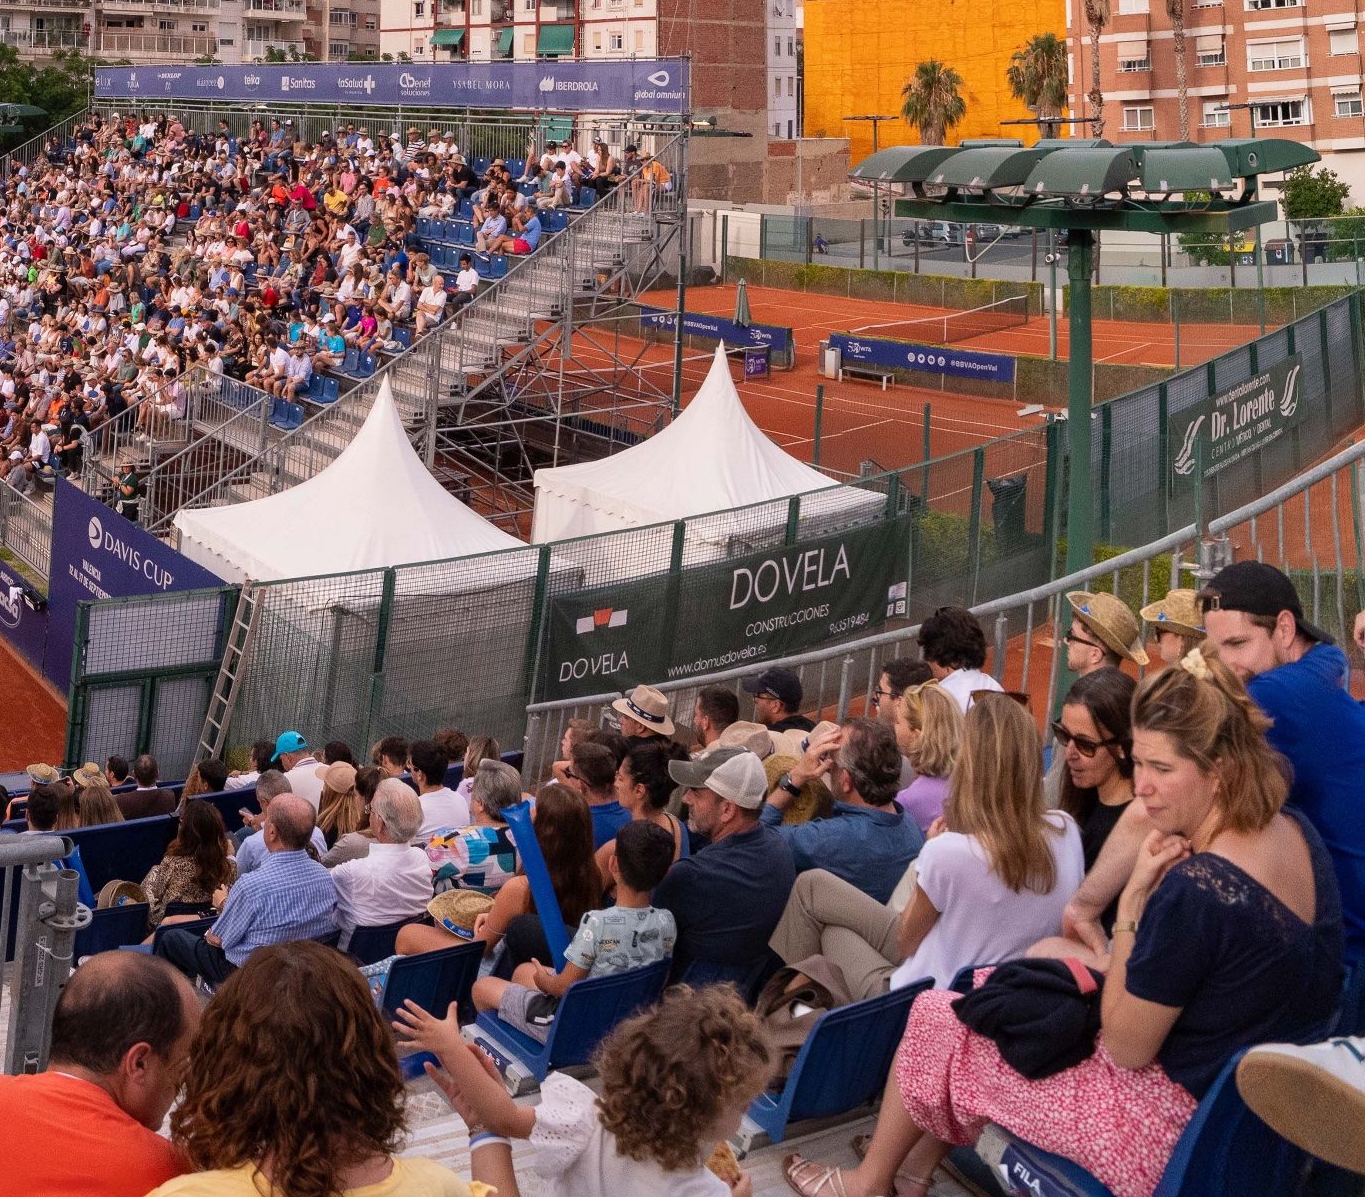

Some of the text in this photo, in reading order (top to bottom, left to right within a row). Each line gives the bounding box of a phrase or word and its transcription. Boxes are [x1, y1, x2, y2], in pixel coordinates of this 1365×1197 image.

[244, 74, 260, 85] teika
[290, 77, 315, 89] Sanitas
[453, 80, 510, 90] YSABEL MORA
[555, 81, 598, 92] IBERDROLA
[400, 89, 431, 97] soluciones
[634, 89, 656, 101] global
[951, 359, 998, 372] @BBVAOpenVal
[1211, 387, 1275, 442] Dr. Lorente
[82, 558, 101, 581] VALENCIA
[104, 531, 173, 590] DAVIS CUP
[69, 564, 74, 575] 12
[74, 569, 79, 580] AL
[83, 576, 88, 588] DE
[729, 543, 850, 610] DOVELA
[746, 604, 830, 637] CONSTRUCCIONES
[828, 612, 870, 635] 963519484
[559, 650, 629, 682] DOVELA
[668, 643, 768, 678] www.domusdovela.es
[1013, 1161, 1041, 1197] FILA
